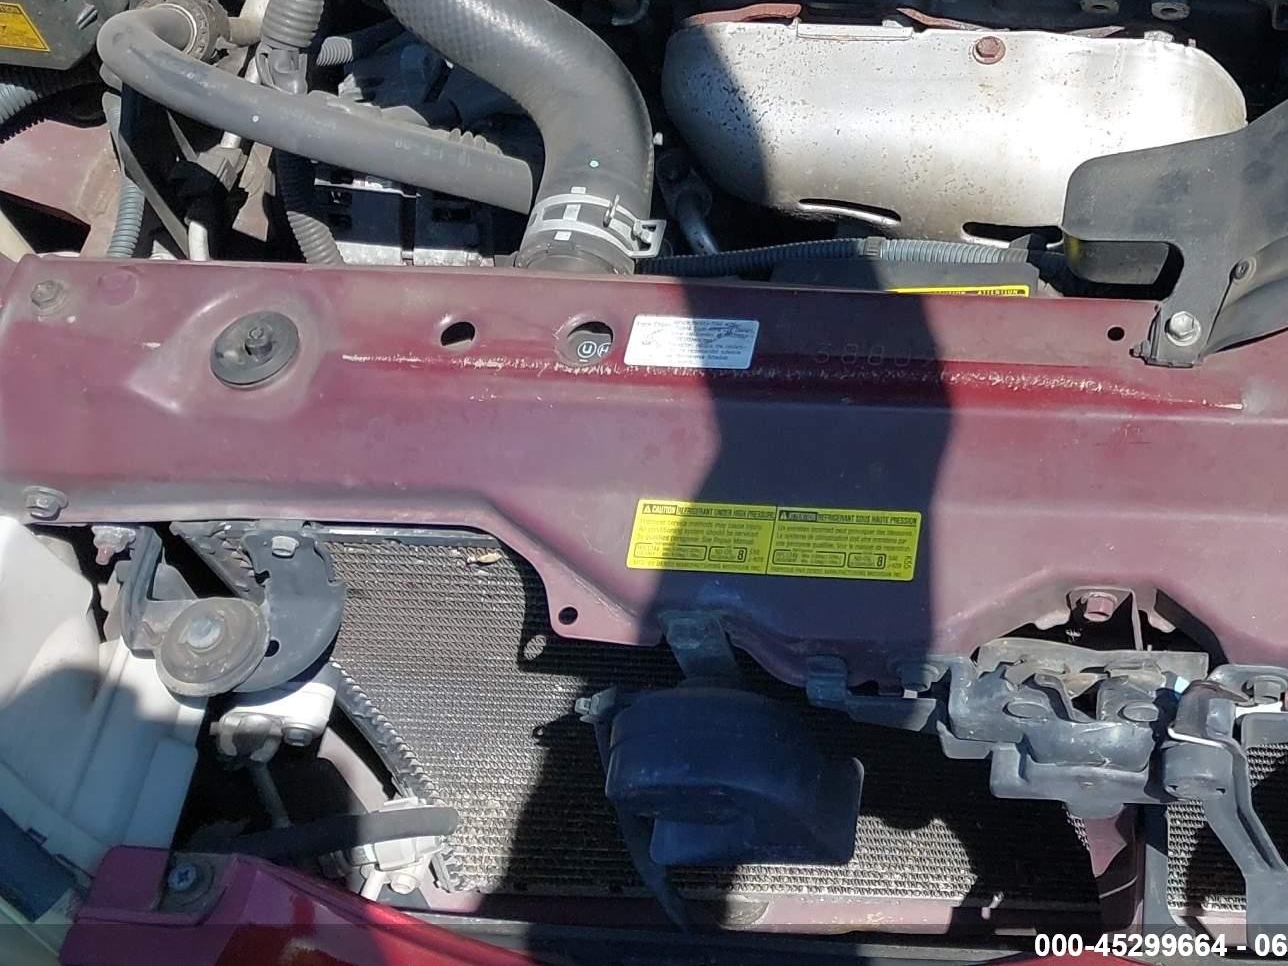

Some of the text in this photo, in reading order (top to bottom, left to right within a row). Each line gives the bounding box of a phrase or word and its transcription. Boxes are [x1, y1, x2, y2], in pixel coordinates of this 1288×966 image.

[652, 505, 676, 514] CAUTION
[677, 506, 712, 515] REFRIGERANT
[737, 549, 744, 561] 8
[877, 556, 883, 567] 8
